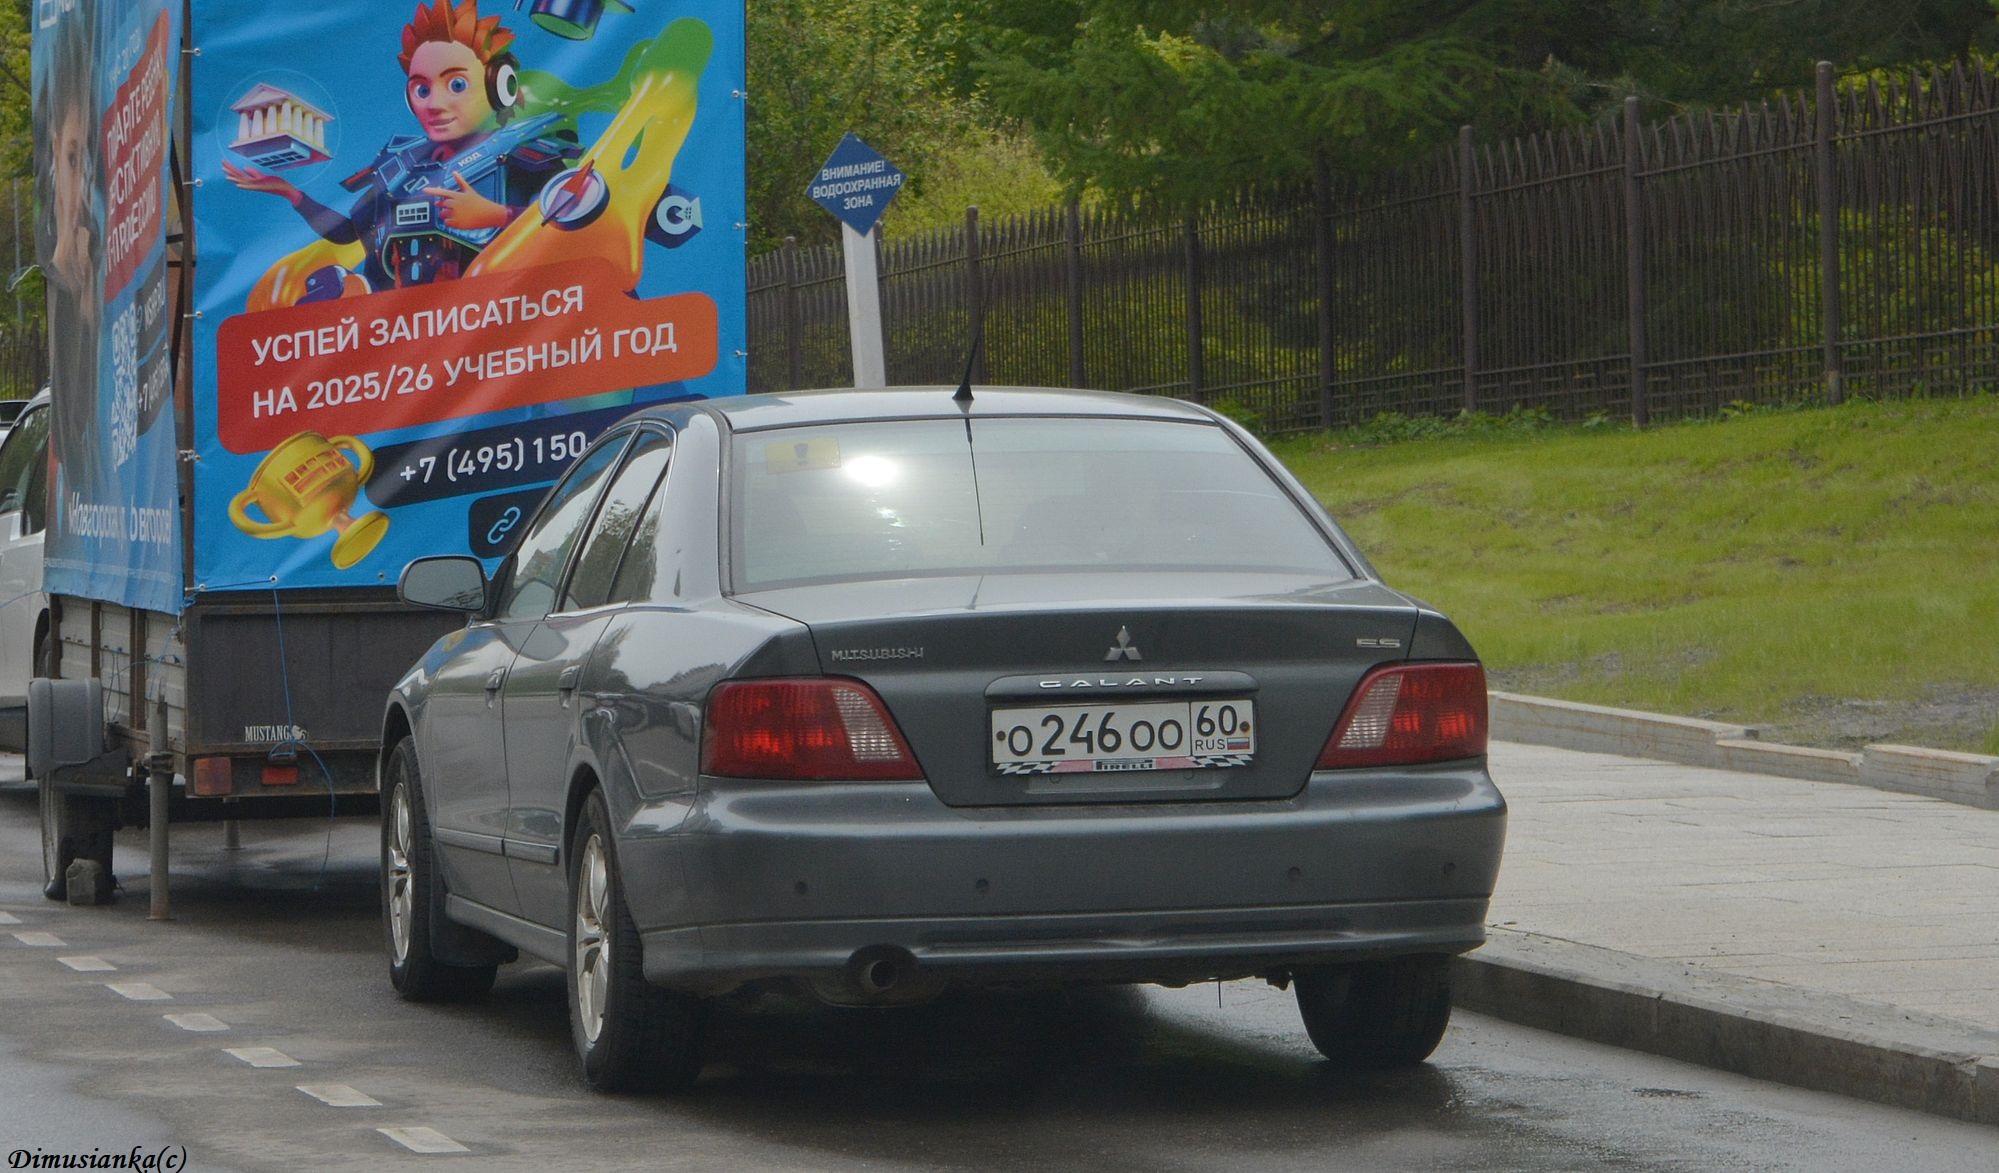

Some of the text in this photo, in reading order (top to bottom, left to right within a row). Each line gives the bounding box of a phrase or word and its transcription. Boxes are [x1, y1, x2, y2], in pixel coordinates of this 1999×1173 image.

[822, 160, 885, 181] ВНИМАНИЕ!
[812, 173, 901, 199] ВОДООХРАННАЯ
[843, 194, 873, 210] ЗОНА
[251, 285, 584, 366] УСПЕЙ ЗАПИСАТЬСЯ
[252, 323, 677, 419] НА 2025/26 УЧЕБНЫЙ ГОД
[400, 456, 436, 483] +7
[447, 437, 524, 482] (495)
[831, 647, 924, 661] MITSUBISHI
[1039, 677, 1204, 689] GALANT
[1197, 705, 1238, 737] 60
[244, 725, 291, 742] MUSTANG
[1195, 738, 1225, 751] RUS
[1096, 759, 1153, 770] PIRELLI
